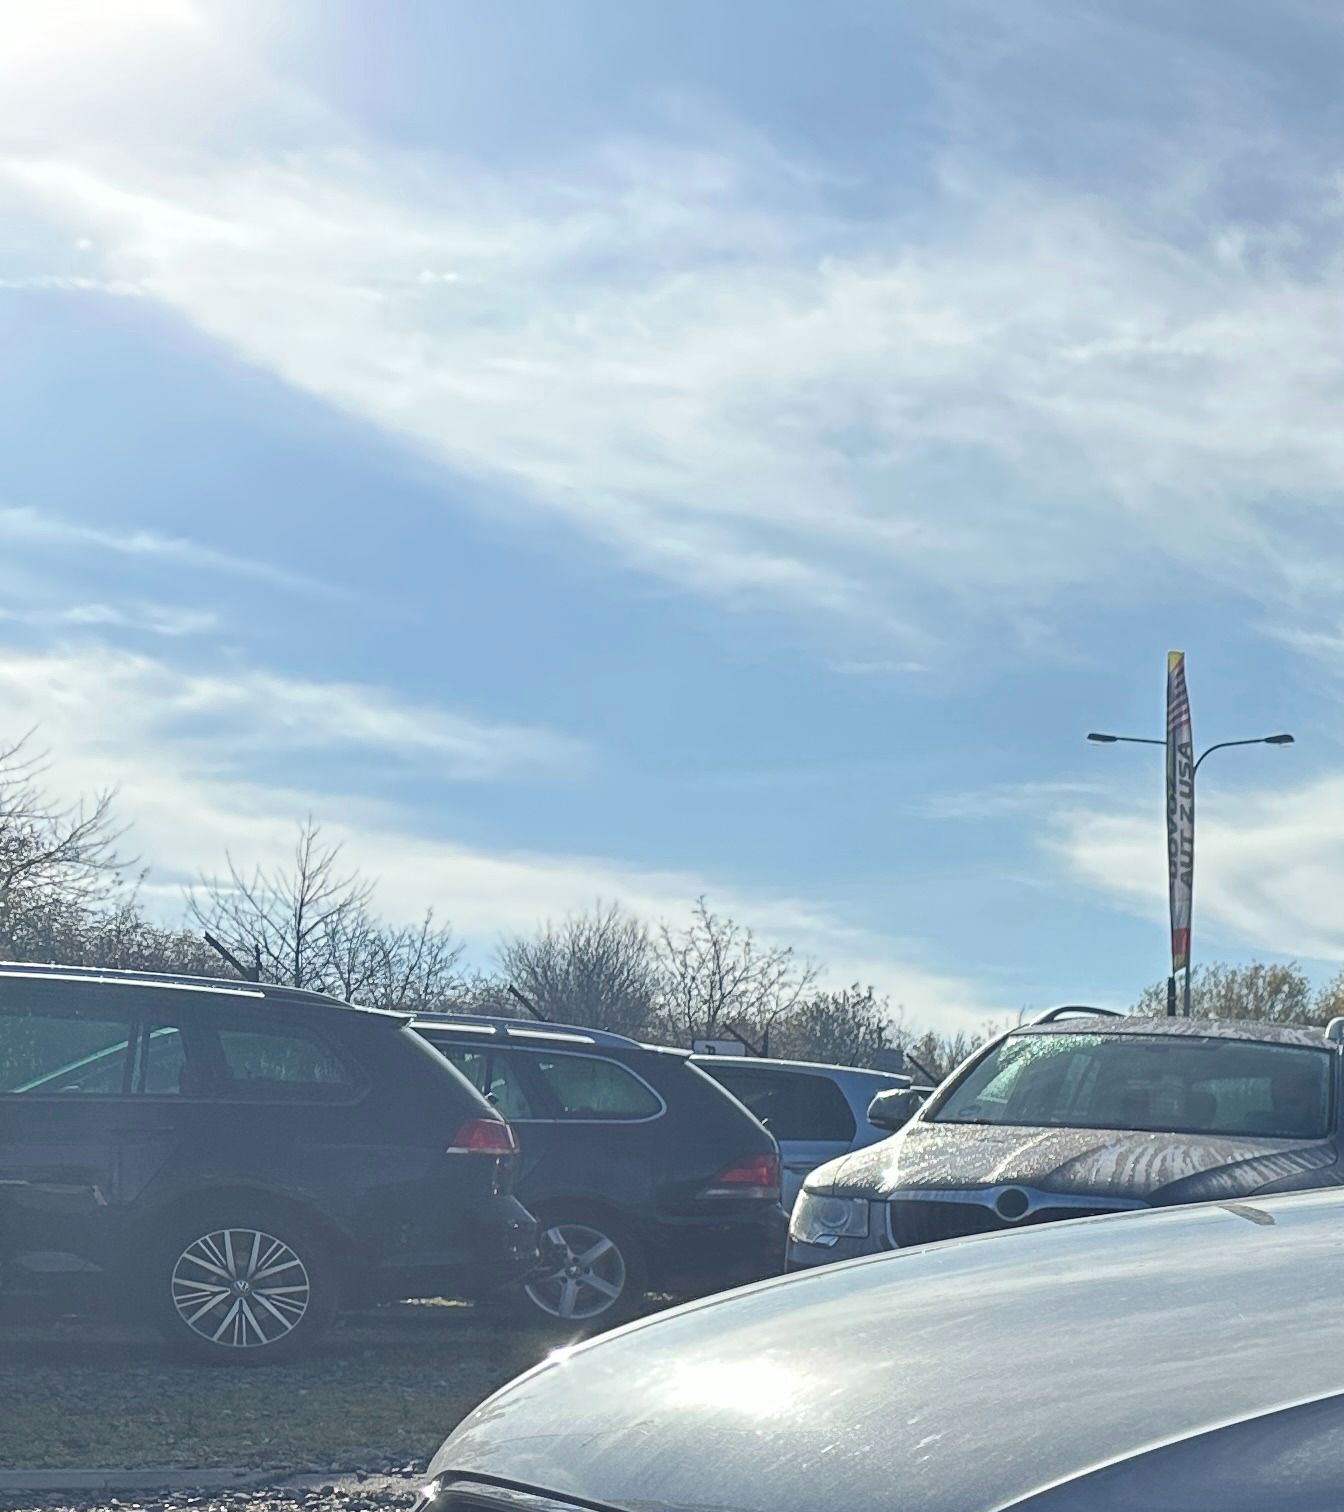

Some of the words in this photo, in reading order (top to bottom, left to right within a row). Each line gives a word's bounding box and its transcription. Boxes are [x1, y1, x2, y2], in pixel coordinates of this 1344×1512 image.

[1177, 741, 1193, 800] USA
[1180, 803, 1193, 824] Z
[1179, 828, 1193, 890] AUT
